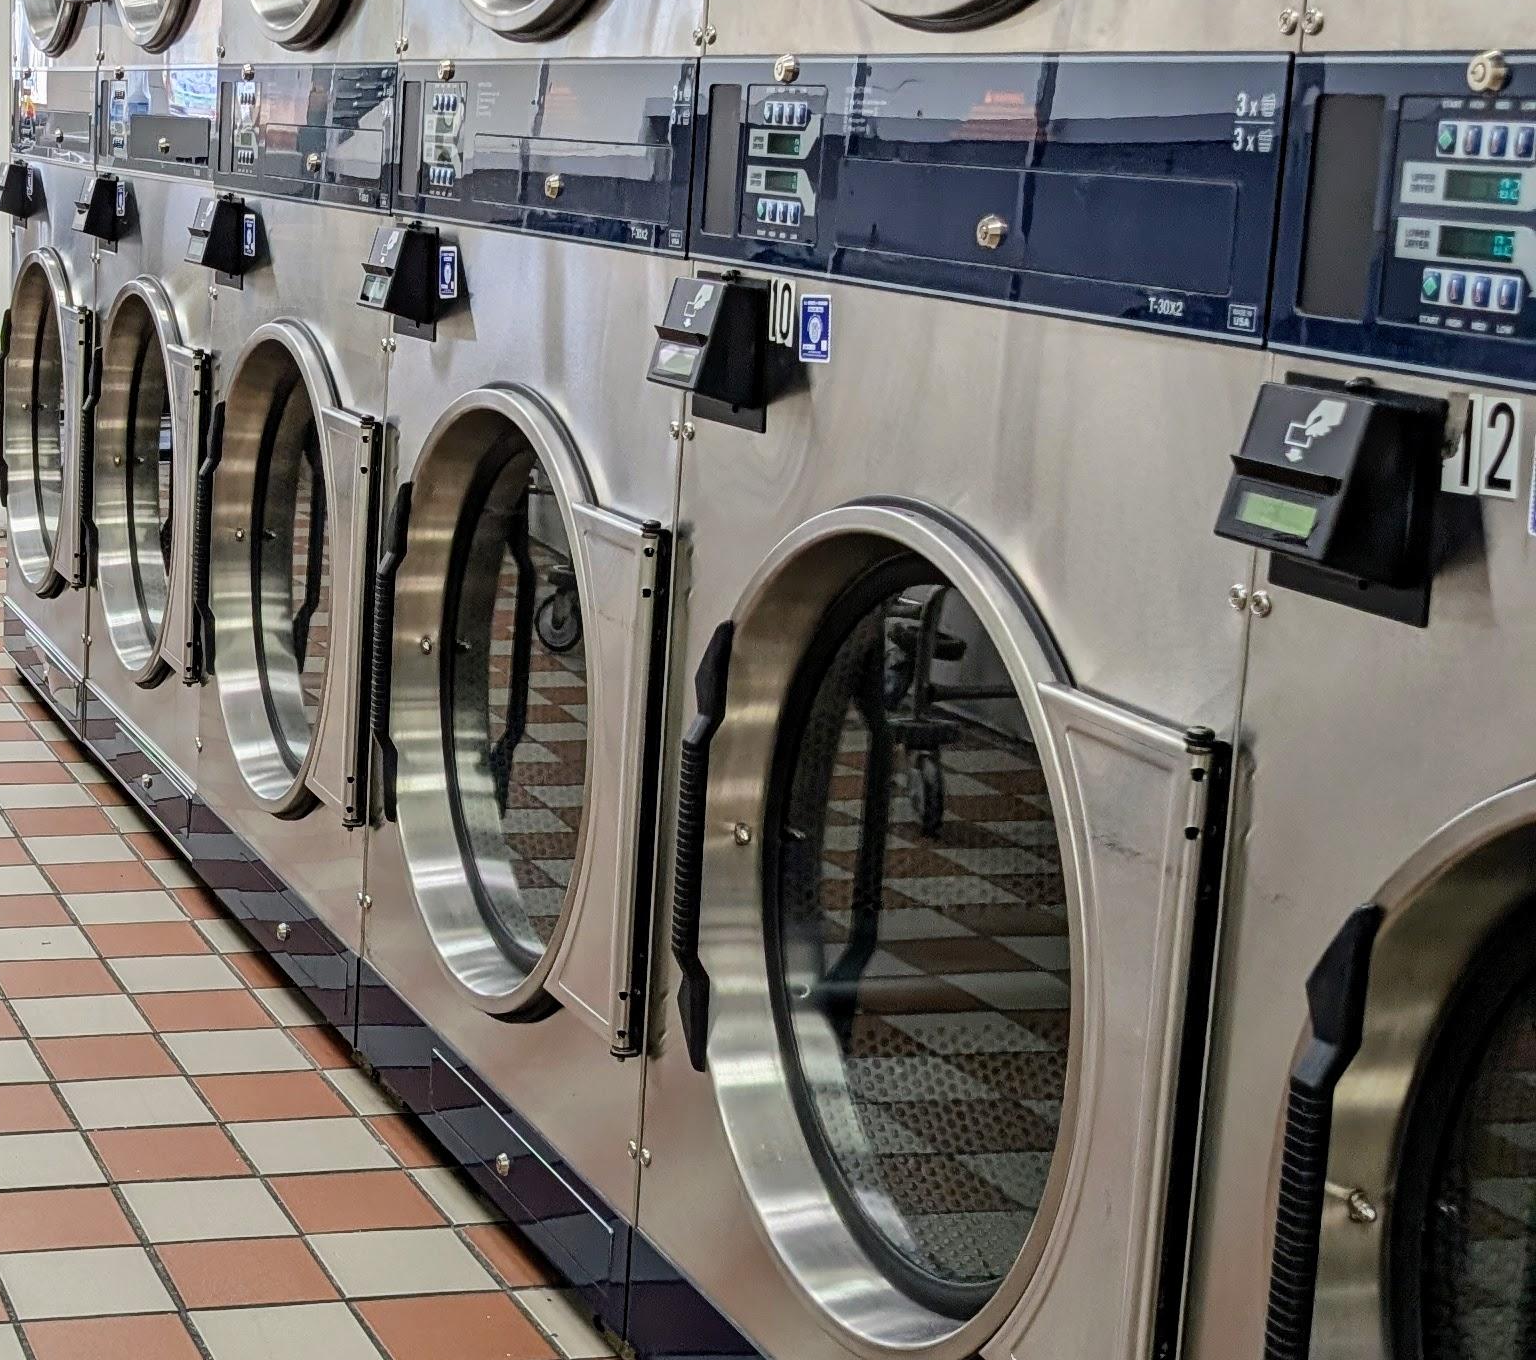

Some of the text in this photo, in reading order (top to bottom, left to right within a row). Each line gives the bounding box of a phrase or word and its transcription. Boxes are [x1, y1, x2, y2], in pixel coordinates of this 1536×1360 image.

[1236, 93, 1246, 117] 3
[1233, 128, 1243, 151] 3
[772, 279, 792, 341] 10
[1232, 317, 1251, 327] USA
[1458, 398, 1516, 491] 12
